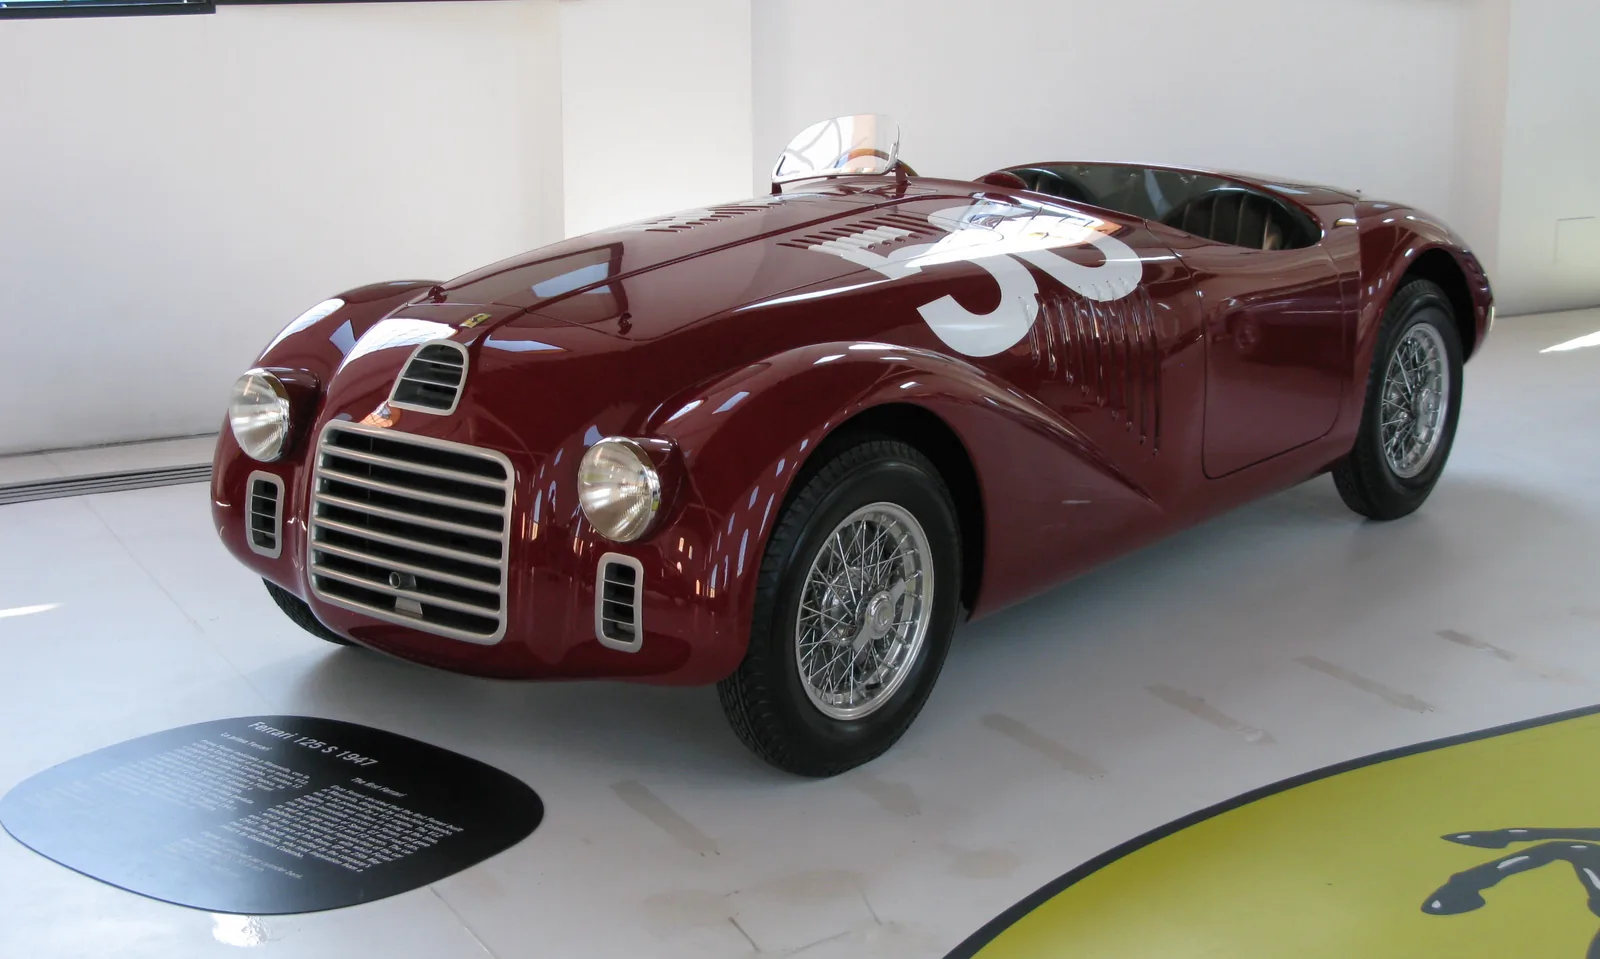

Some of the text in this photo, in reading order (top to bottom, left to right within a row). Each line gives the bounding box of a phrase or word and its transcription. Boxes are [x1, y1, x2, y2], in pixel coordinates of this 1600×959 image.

[248, 721, 378, 767] Ferrari 125 S 1947
